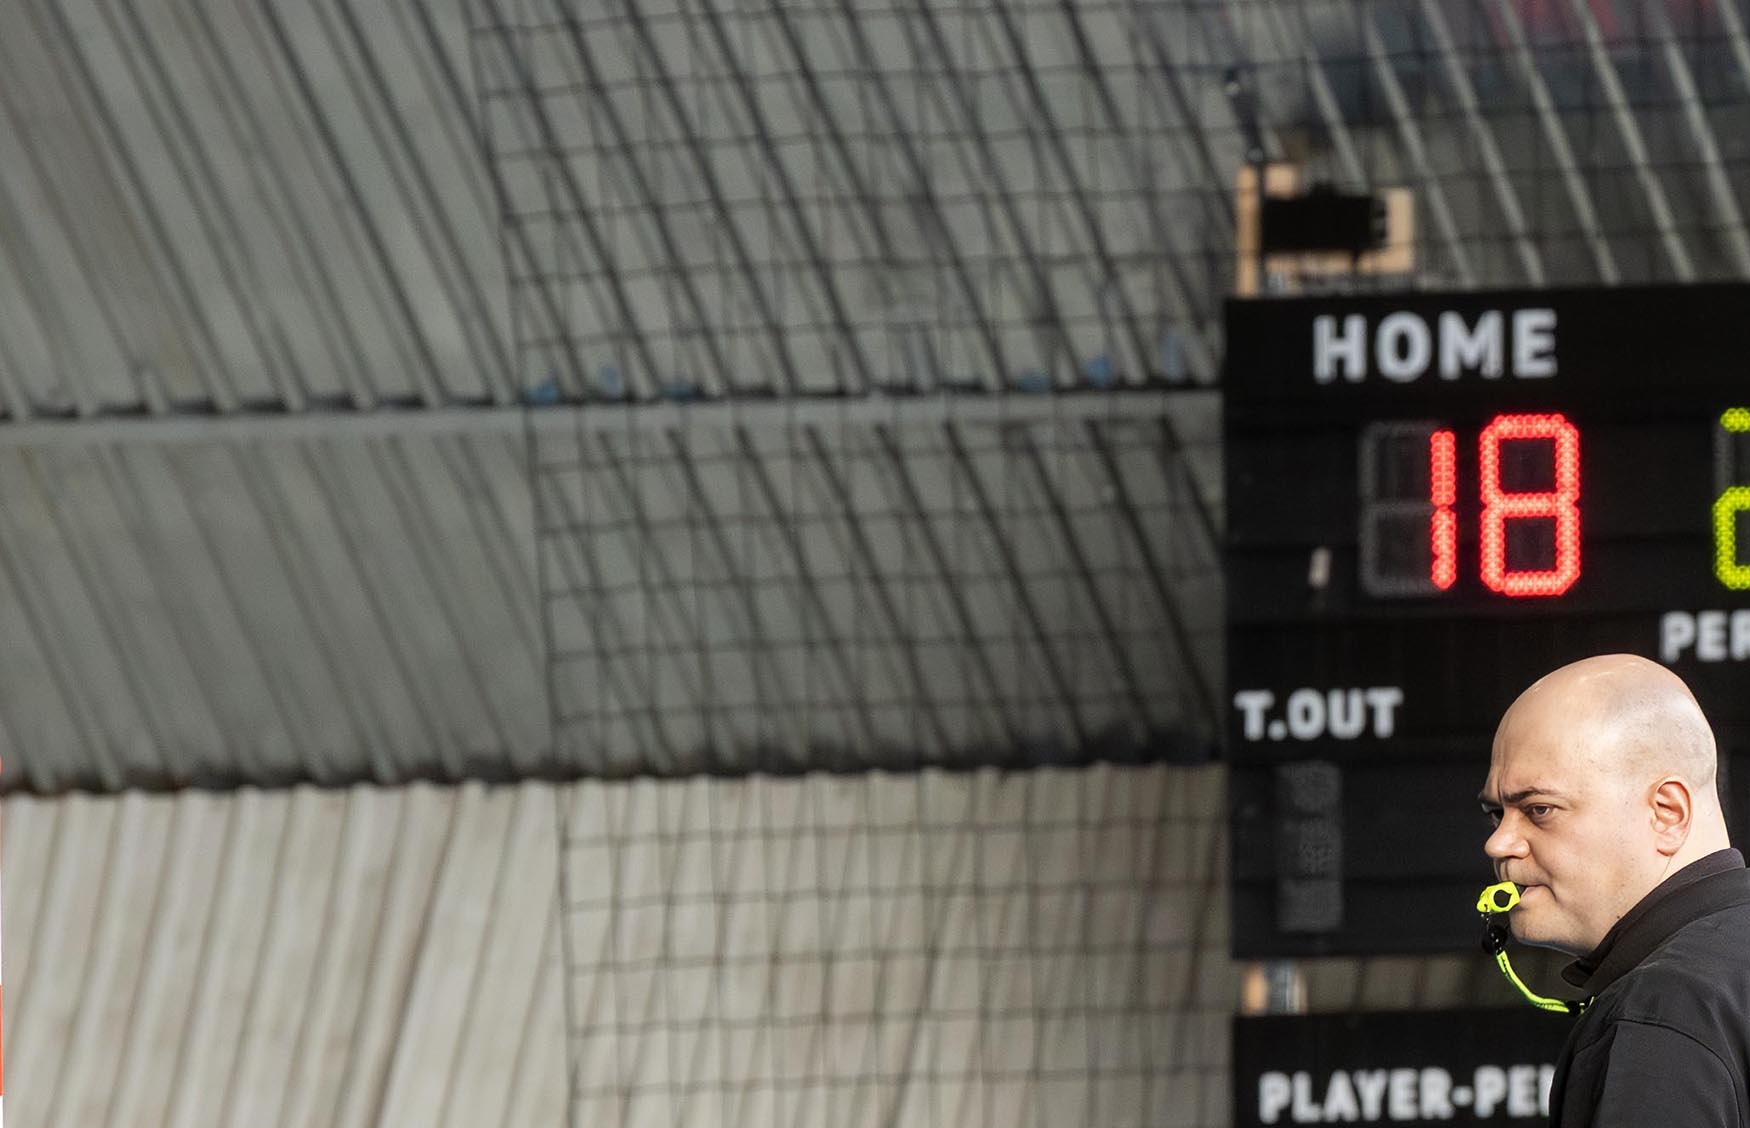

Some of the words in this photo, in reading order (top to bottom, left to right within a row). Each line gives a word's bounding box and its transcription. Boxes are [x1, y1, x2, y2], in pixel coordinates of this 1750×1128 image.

[1313, 309, 1558, 382] HOME
[1429, 412, 1582, 598] 18
[1234, 686, 1404, 741] T.OUT
